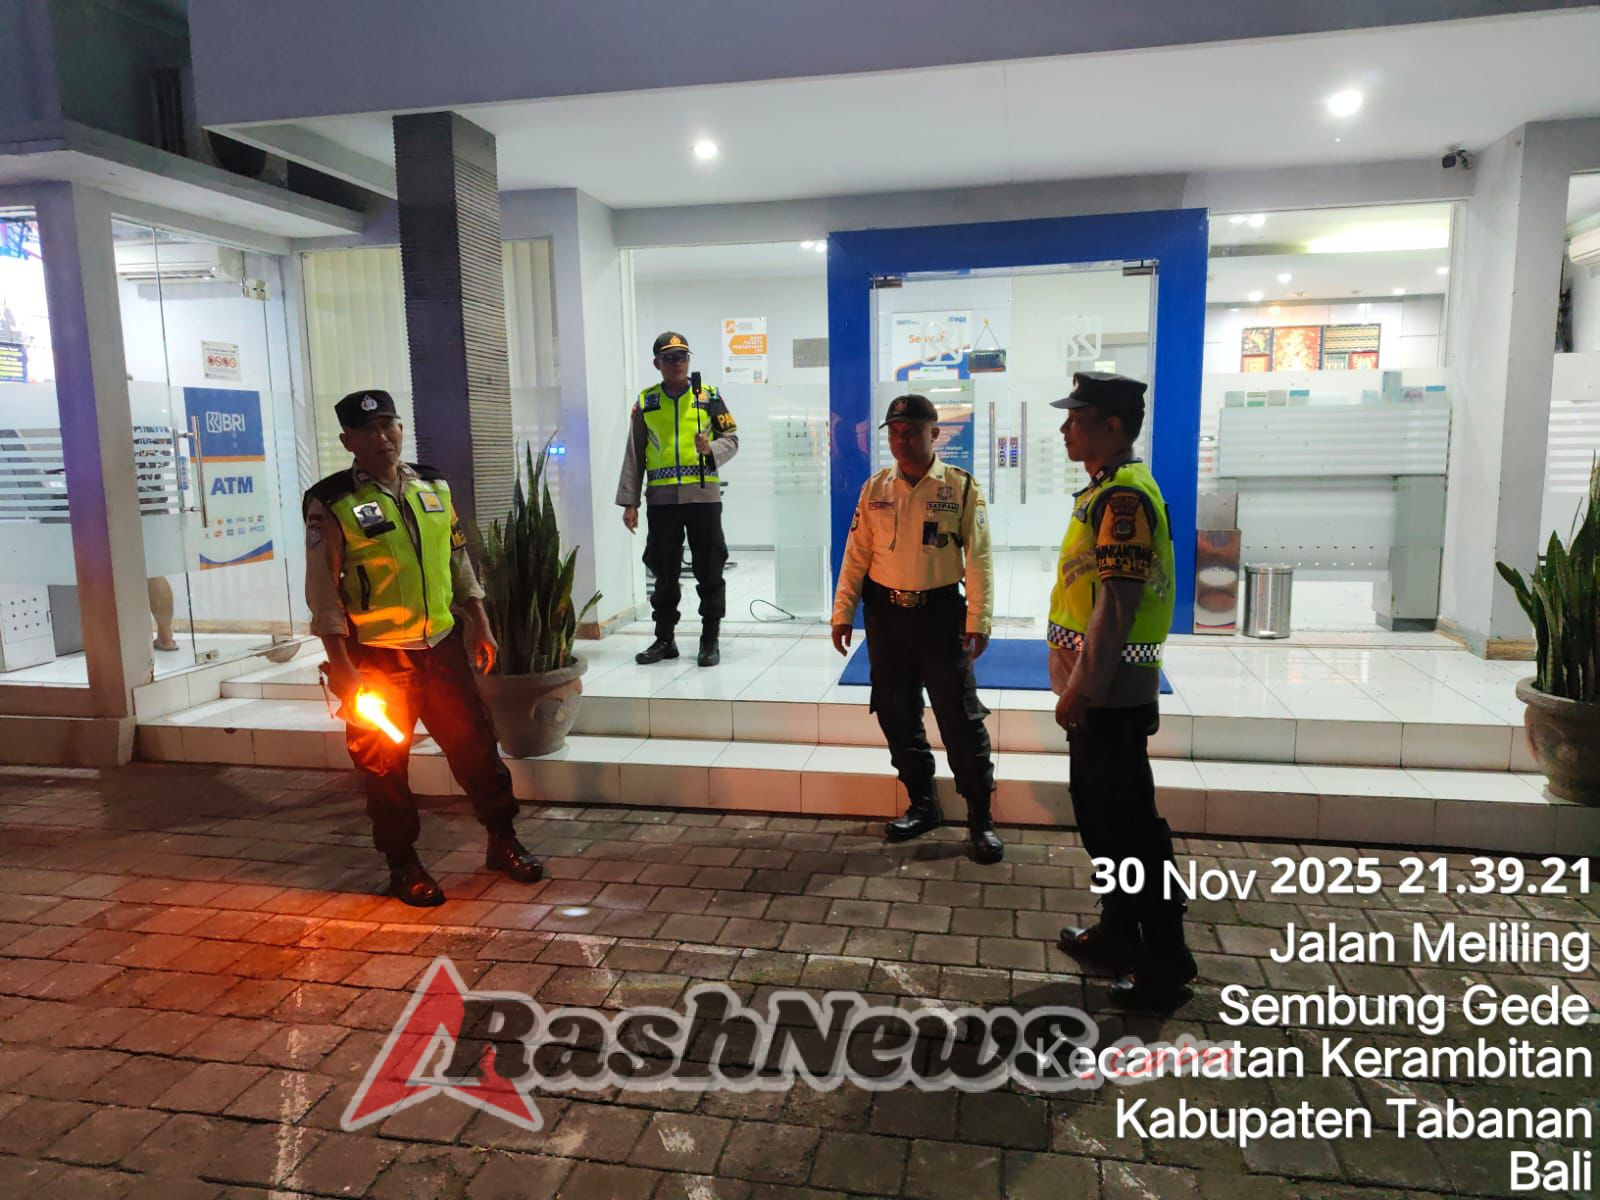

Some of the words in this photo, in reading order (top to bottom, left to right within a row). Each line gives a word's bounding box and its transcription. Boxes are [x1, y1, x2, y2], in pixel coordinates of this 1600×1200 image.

[221, 413, 246, 432] BRI
[210, 475, 254, 496] ATM
[927, 502, 959, 513] SATPAM
